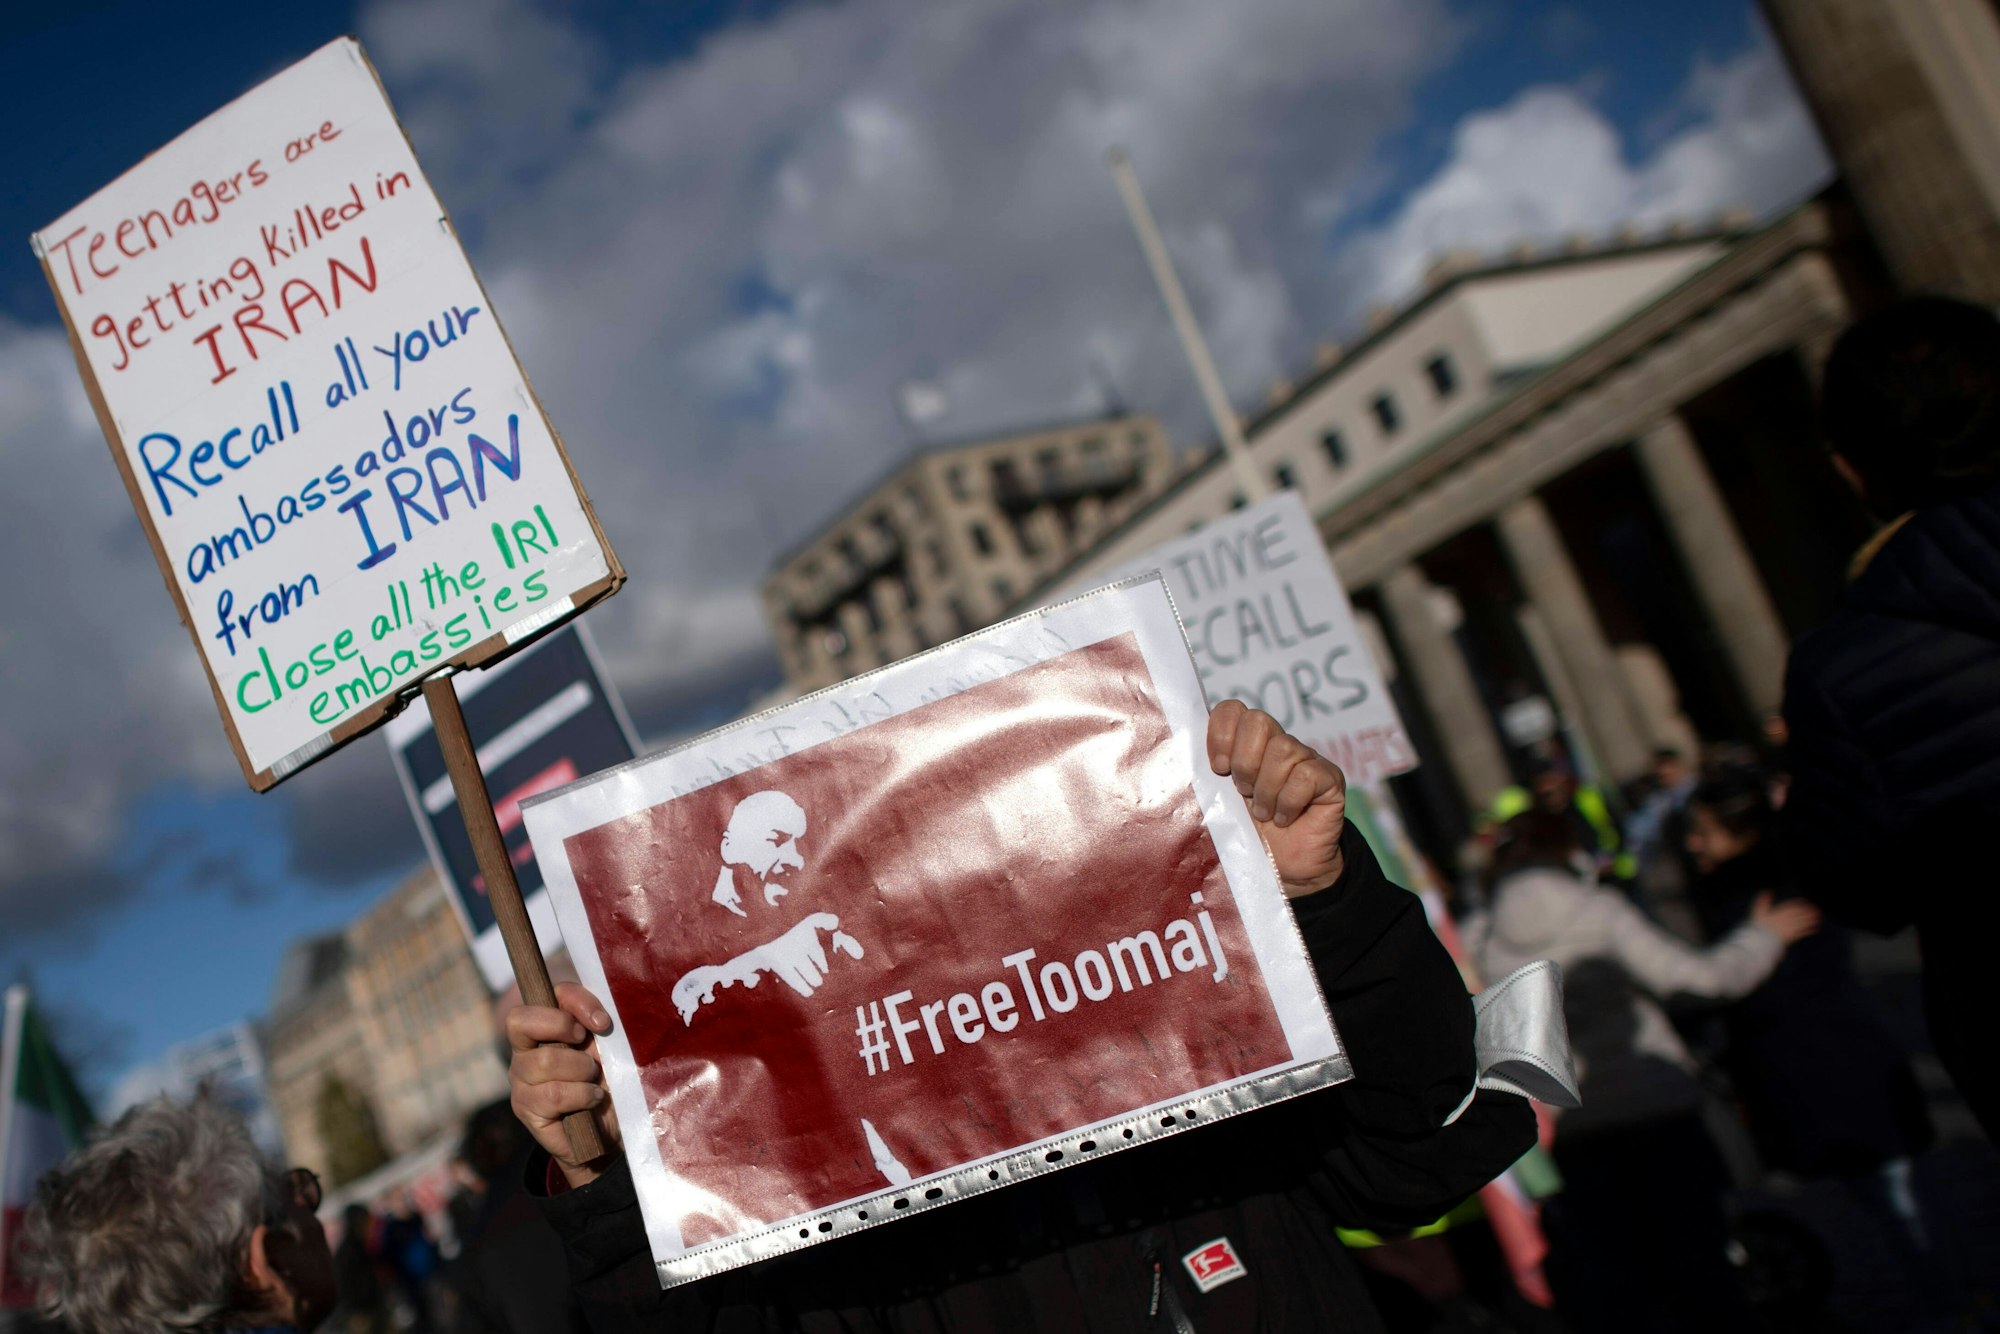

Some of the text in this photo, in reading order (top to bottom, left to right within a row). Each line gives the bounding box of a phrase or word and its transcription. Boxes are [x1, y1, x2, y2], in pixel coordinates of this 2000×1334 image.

[50, 121, 341, 295] Teenagers are
[91, 258, 265, 371] getting
[376, 172, 411, 200] in
[194, 237, 378, 384] IRAN
[138, 306, 480, 516] Recall all your
[187, 387, 476, 584] ambassadors
[216, 413, 521, 656] from IRAN
[236, 504, 559, 714] close all the IRI
[1184, 583, 1333, 678] ECALL
[309, 570, 549, 724] embassies
[855, 890, 1229, 1077] #FreeToomaj
